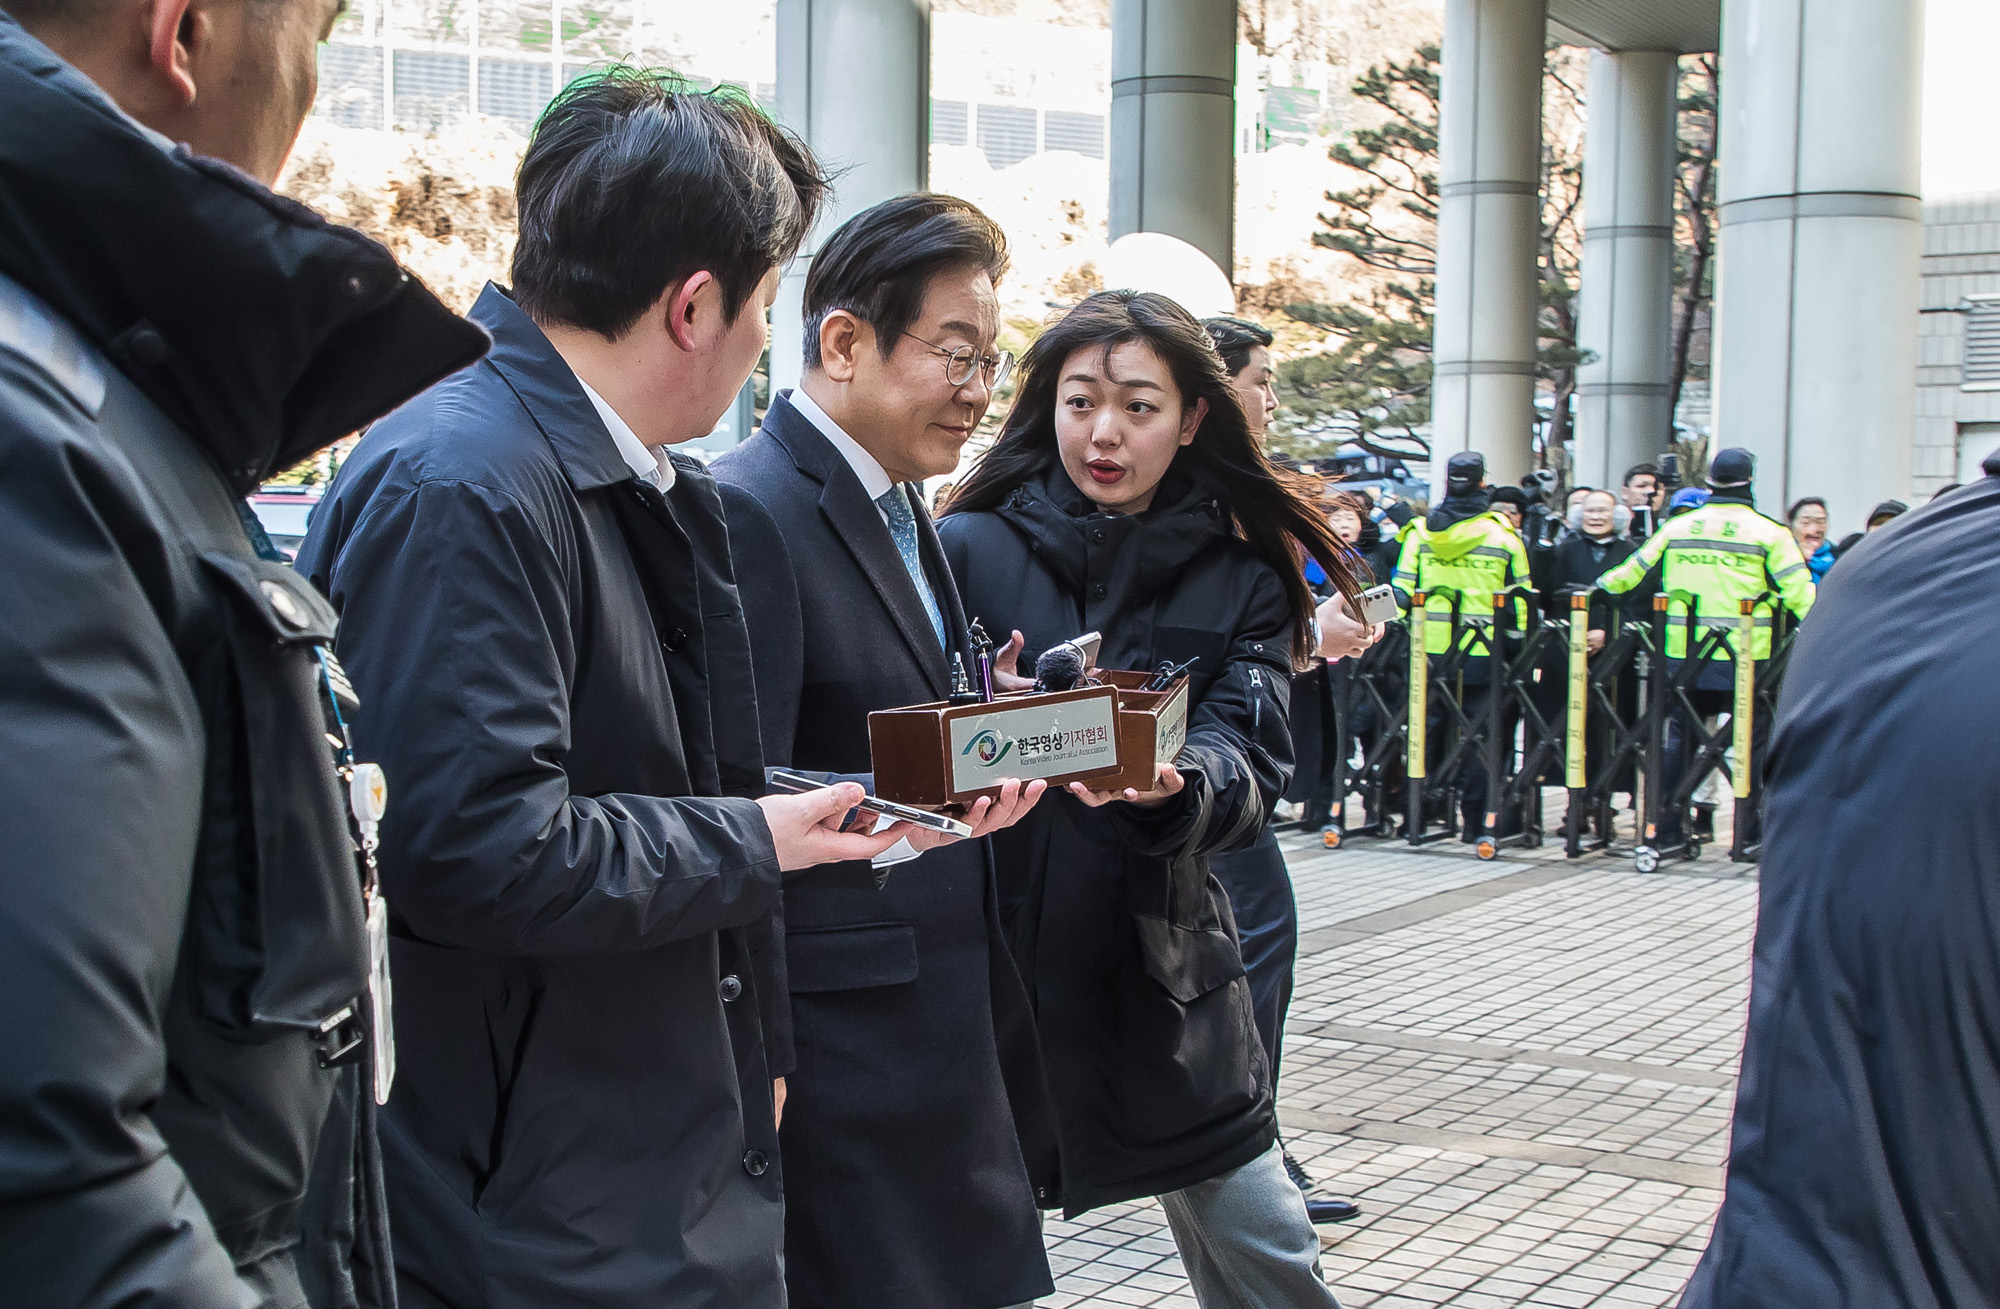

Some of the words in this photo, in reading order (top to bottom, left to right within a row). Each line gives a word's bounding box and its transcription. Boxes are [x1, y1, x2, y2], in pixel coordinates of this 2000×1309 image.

[1428, 557, 1496, 570] POLICE
[1677, 553, 1746, 567] POLICE
[1017, 724, 1108, 757] 한국영상기자협회
[1020, 756, 1037, 766] Korea
[1036, 754, 1053, 764] Video
[1079, 745, 1109, 757] Association
